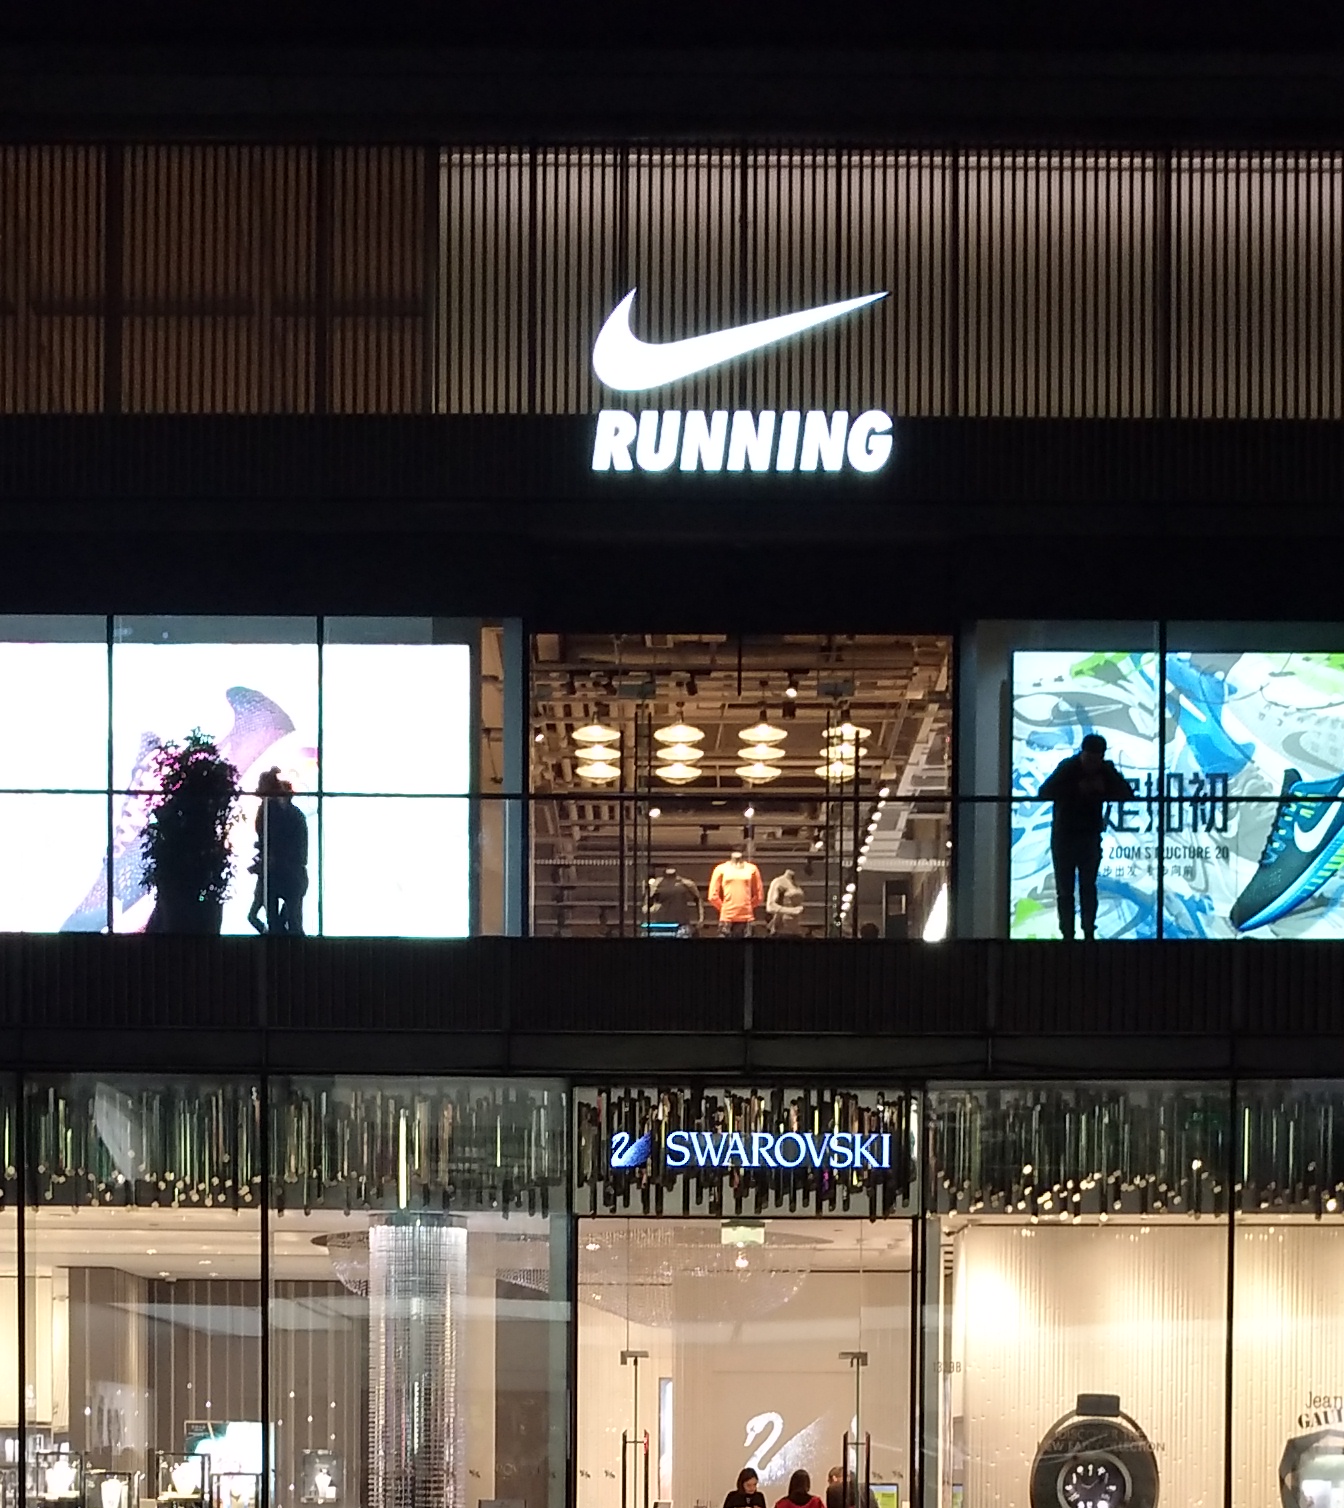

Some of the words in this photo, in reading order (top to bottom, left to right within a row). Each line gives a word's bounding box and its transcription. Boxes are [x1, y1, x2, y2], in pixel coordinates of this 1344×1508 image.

[592, 409, 894, 473] RUNNING
[1109, 846, 1141, 859] ZOOM
[1145, 846, 1210, 859] STUCTURE
[1216, 846, 1230, 859] 20
[666, 1130, 892, 1168] SWAROVSKI
[1305, 1391, 1343, 1409] Jean
